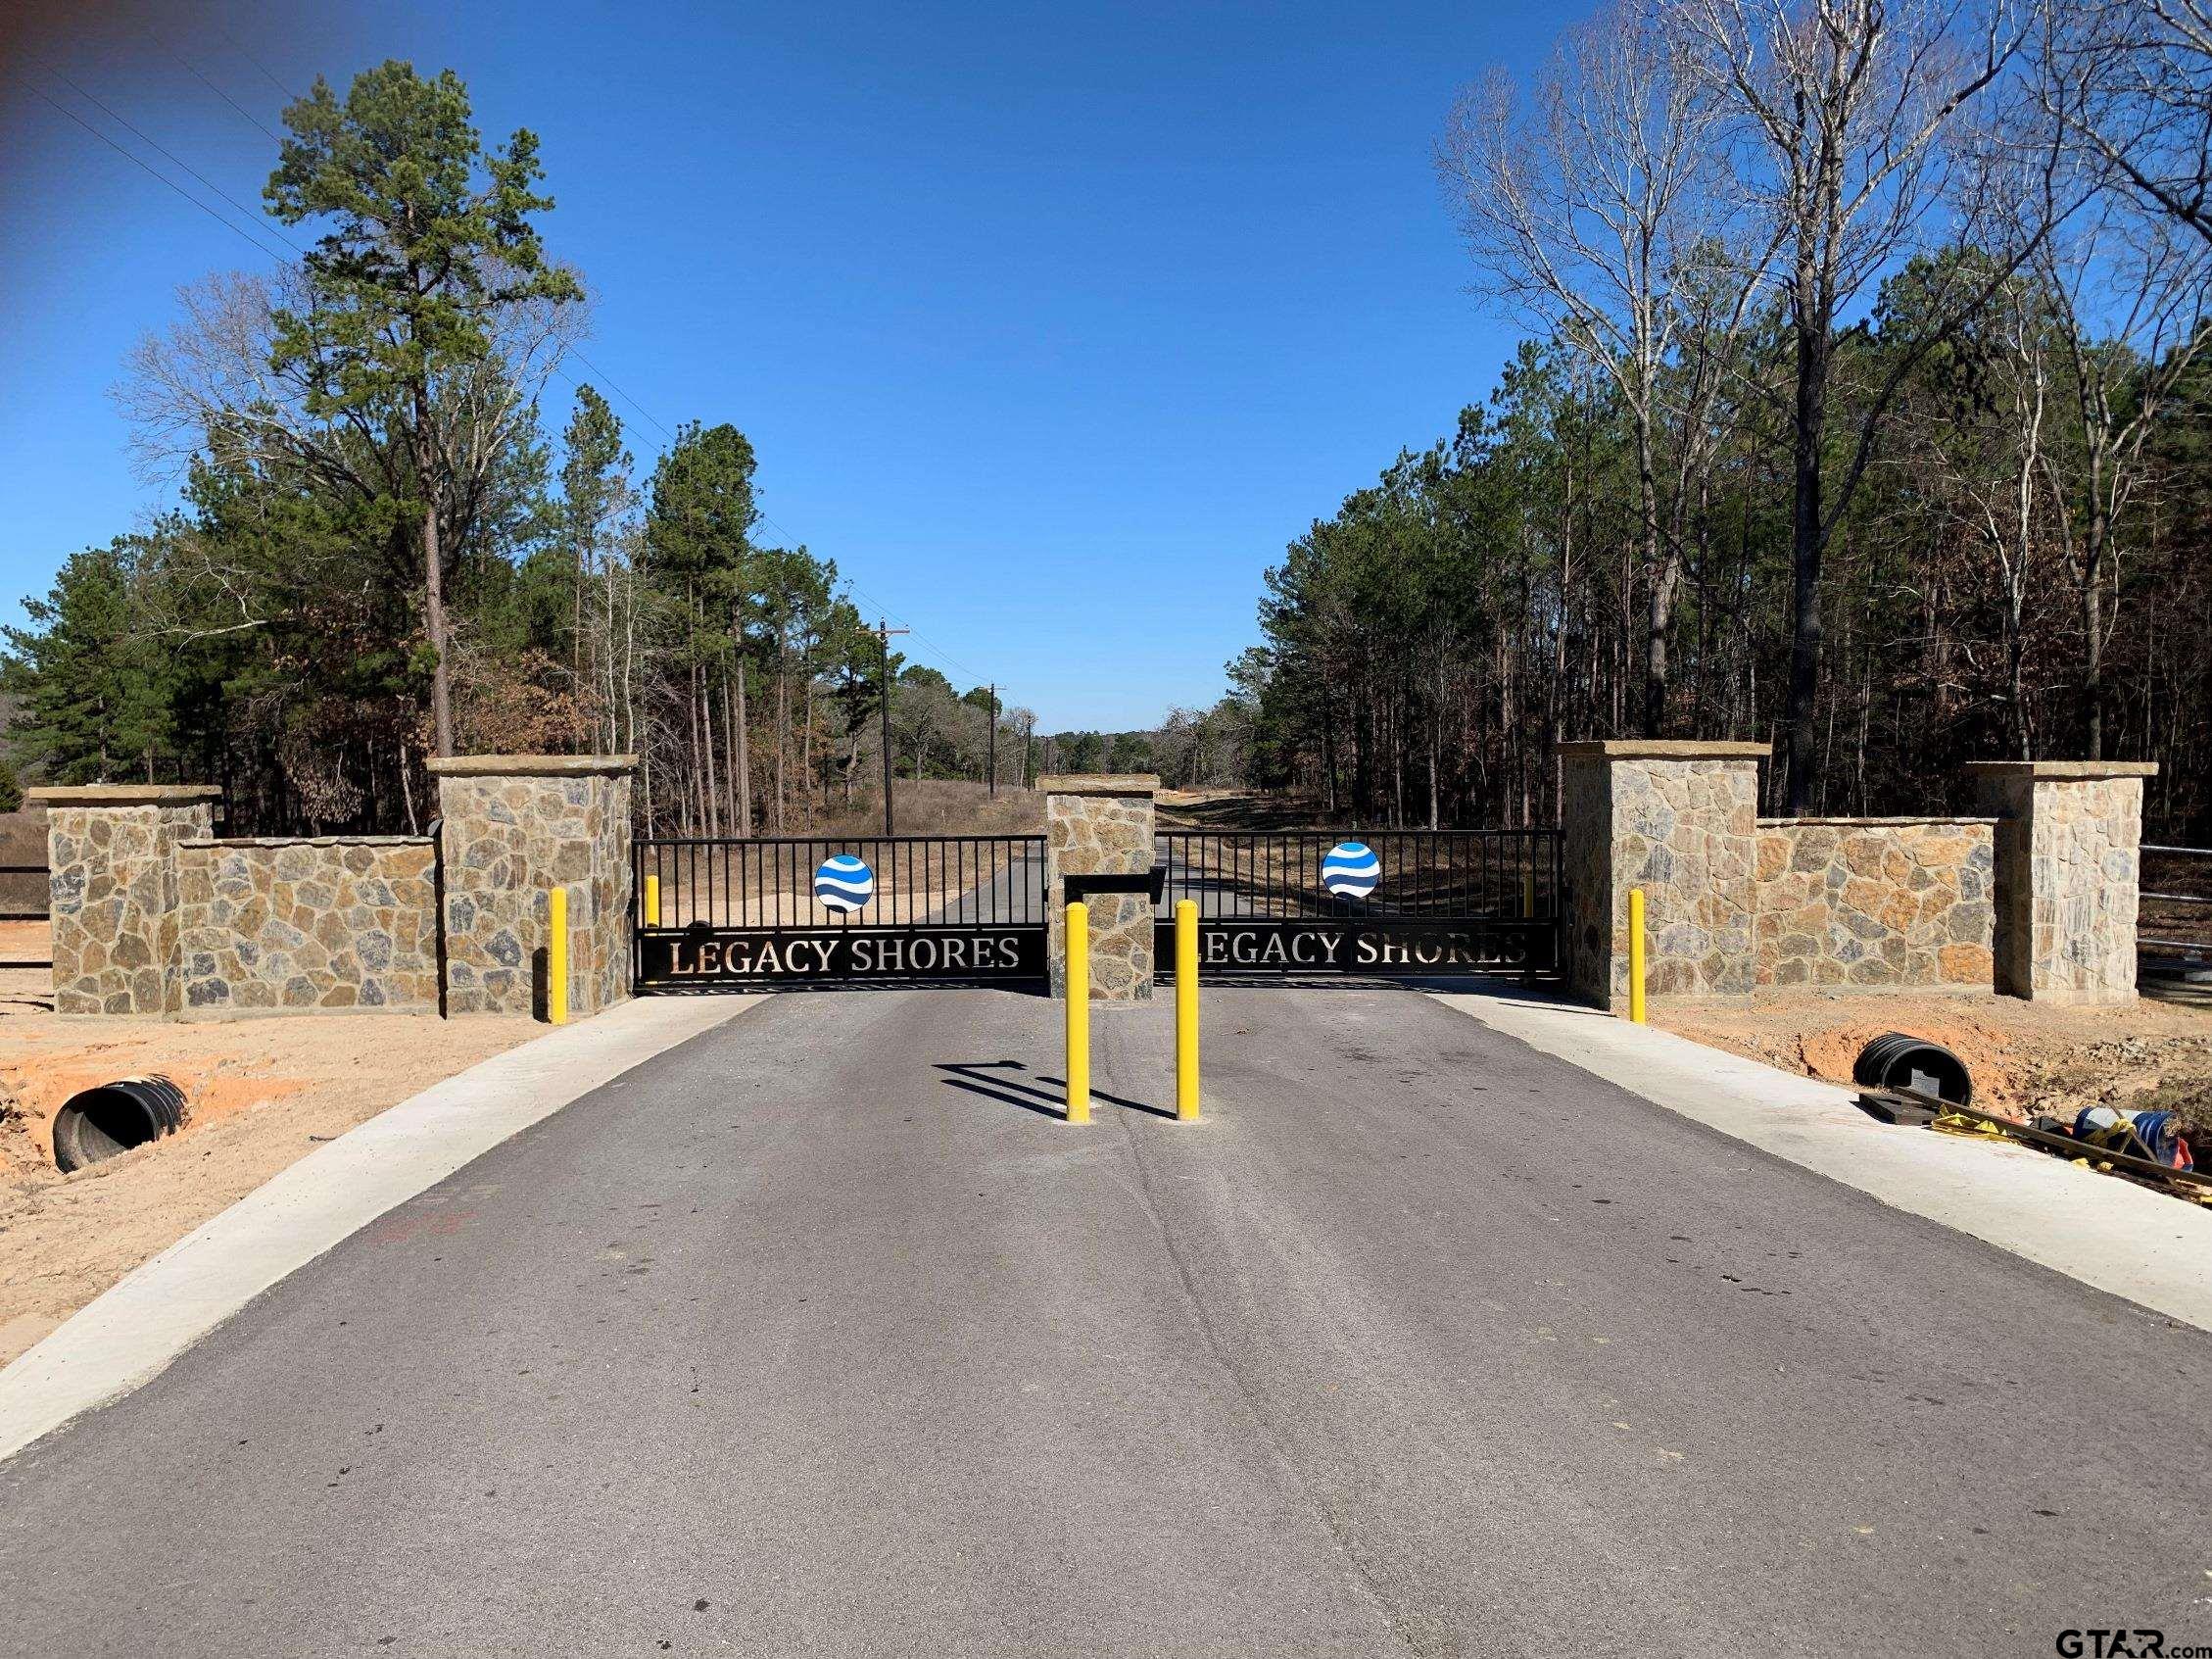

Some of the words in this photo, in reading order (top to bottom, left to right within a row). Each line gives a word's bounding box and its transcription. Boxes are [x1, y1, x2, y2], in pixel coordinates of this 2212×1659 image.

[670, 939, 839, 975] LEGACY
[850, 937, 1020, 972] SHORES
[1198, 931, 1345, 963] EGACY
[1356, 931, 1528, 964] SHORES
